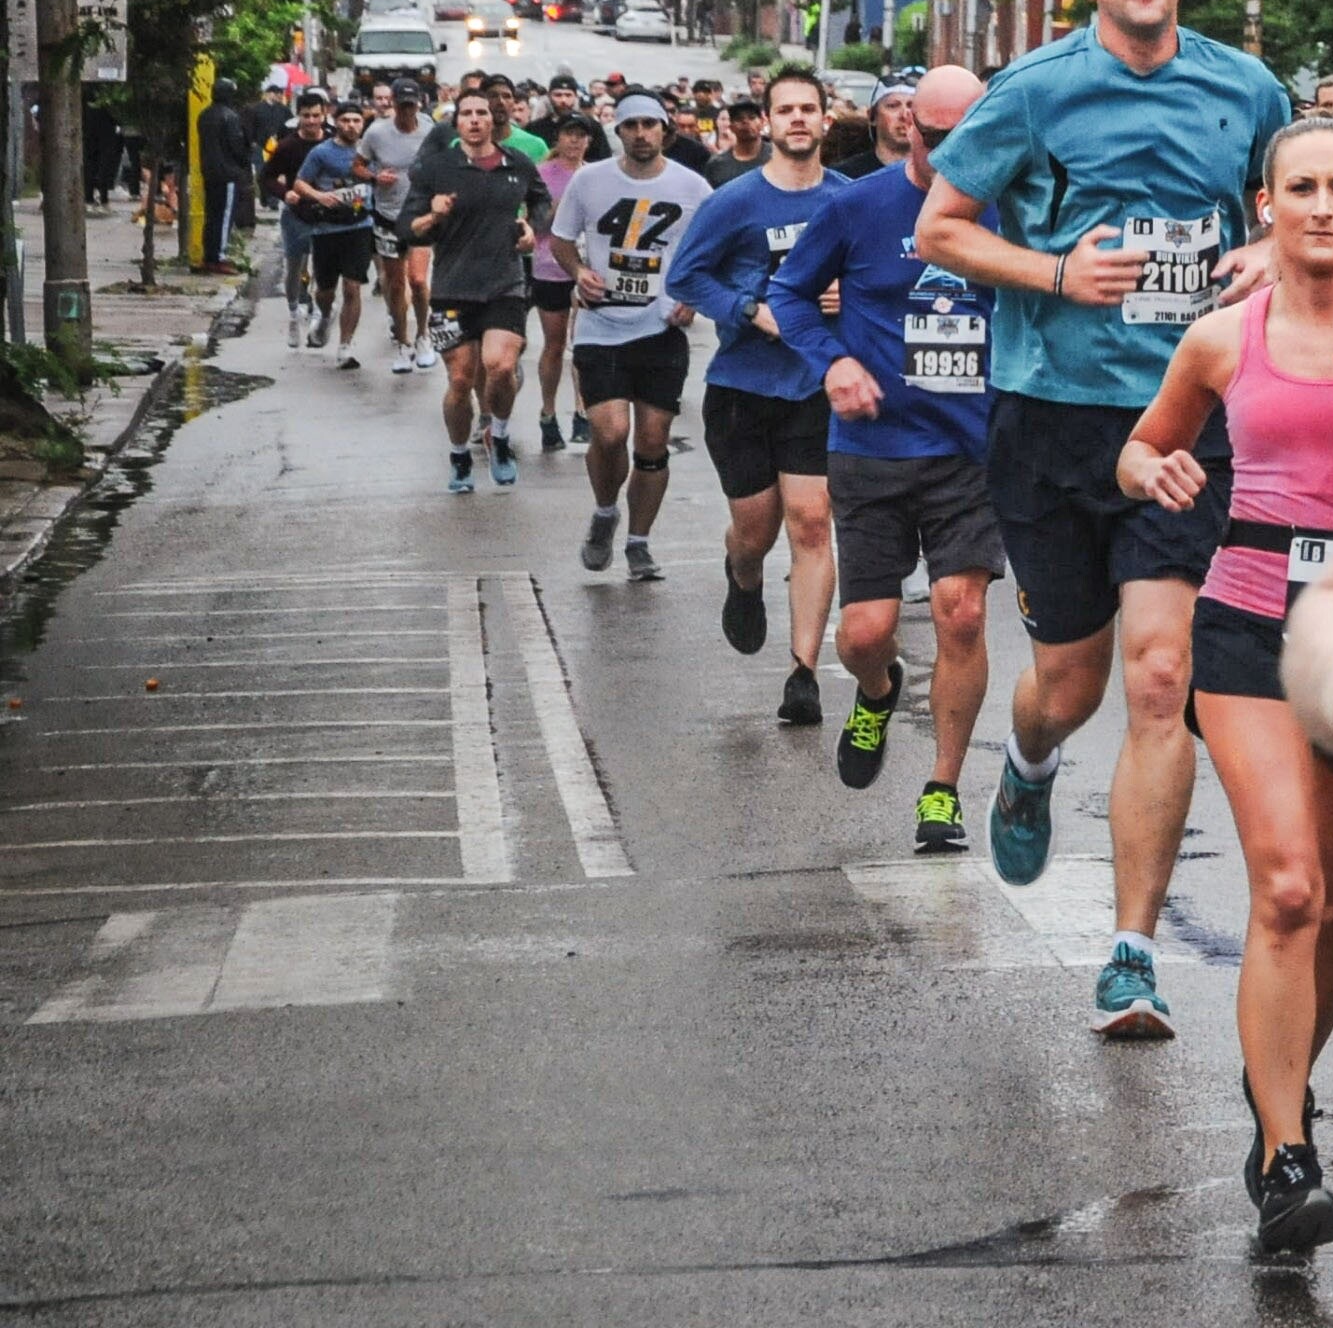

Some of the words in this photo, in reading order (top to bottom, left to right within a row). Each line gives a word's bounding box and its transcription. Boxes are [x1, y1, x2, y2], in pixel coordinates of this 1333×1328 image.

[616, 277, 649, 294] 3610
[1142, 259, 1208, 293] 21101
[1154, 311, 1177, 322] 21101
[913, 351, 979, 377] 19936
